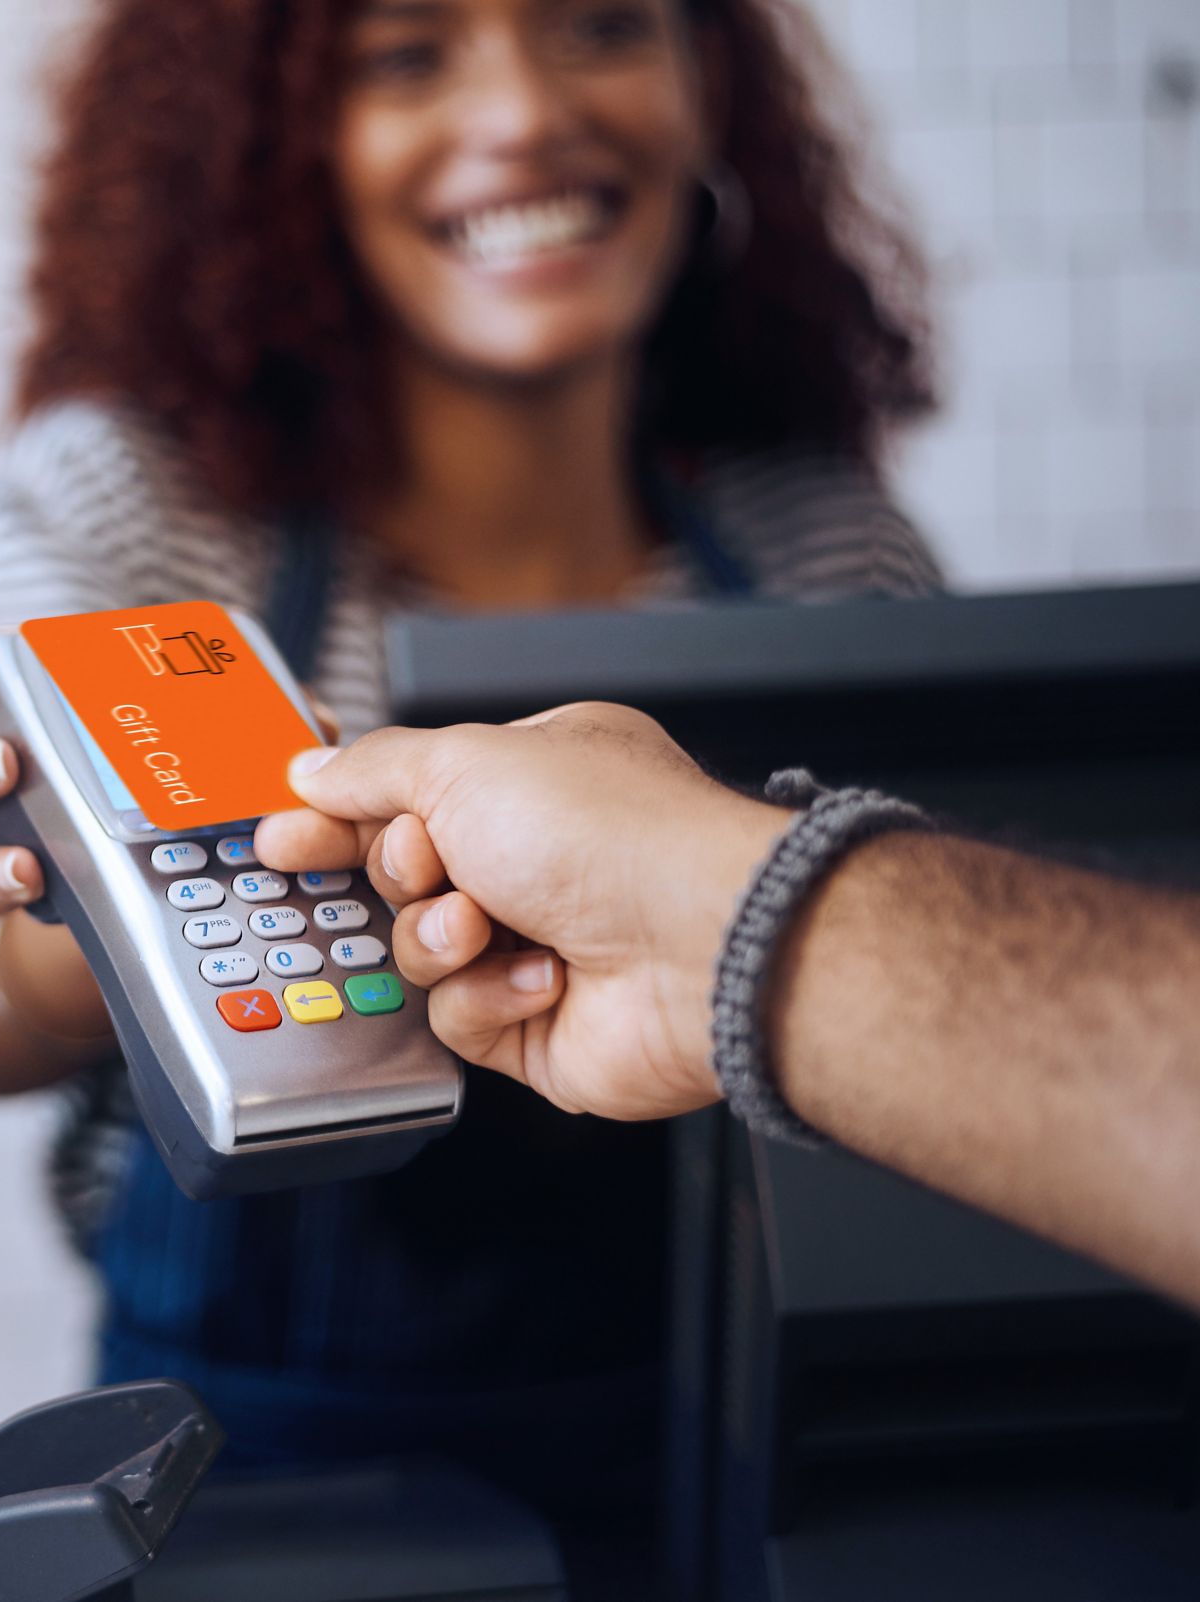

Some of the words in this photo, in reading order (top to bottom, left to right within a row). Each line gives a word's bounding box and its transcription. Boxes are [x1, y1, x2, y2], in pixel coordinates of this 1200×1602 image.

[110, 704, 161, 747] Gift
[143, 751, 207, 806] Card
[275, 951, 293, 967] 0
